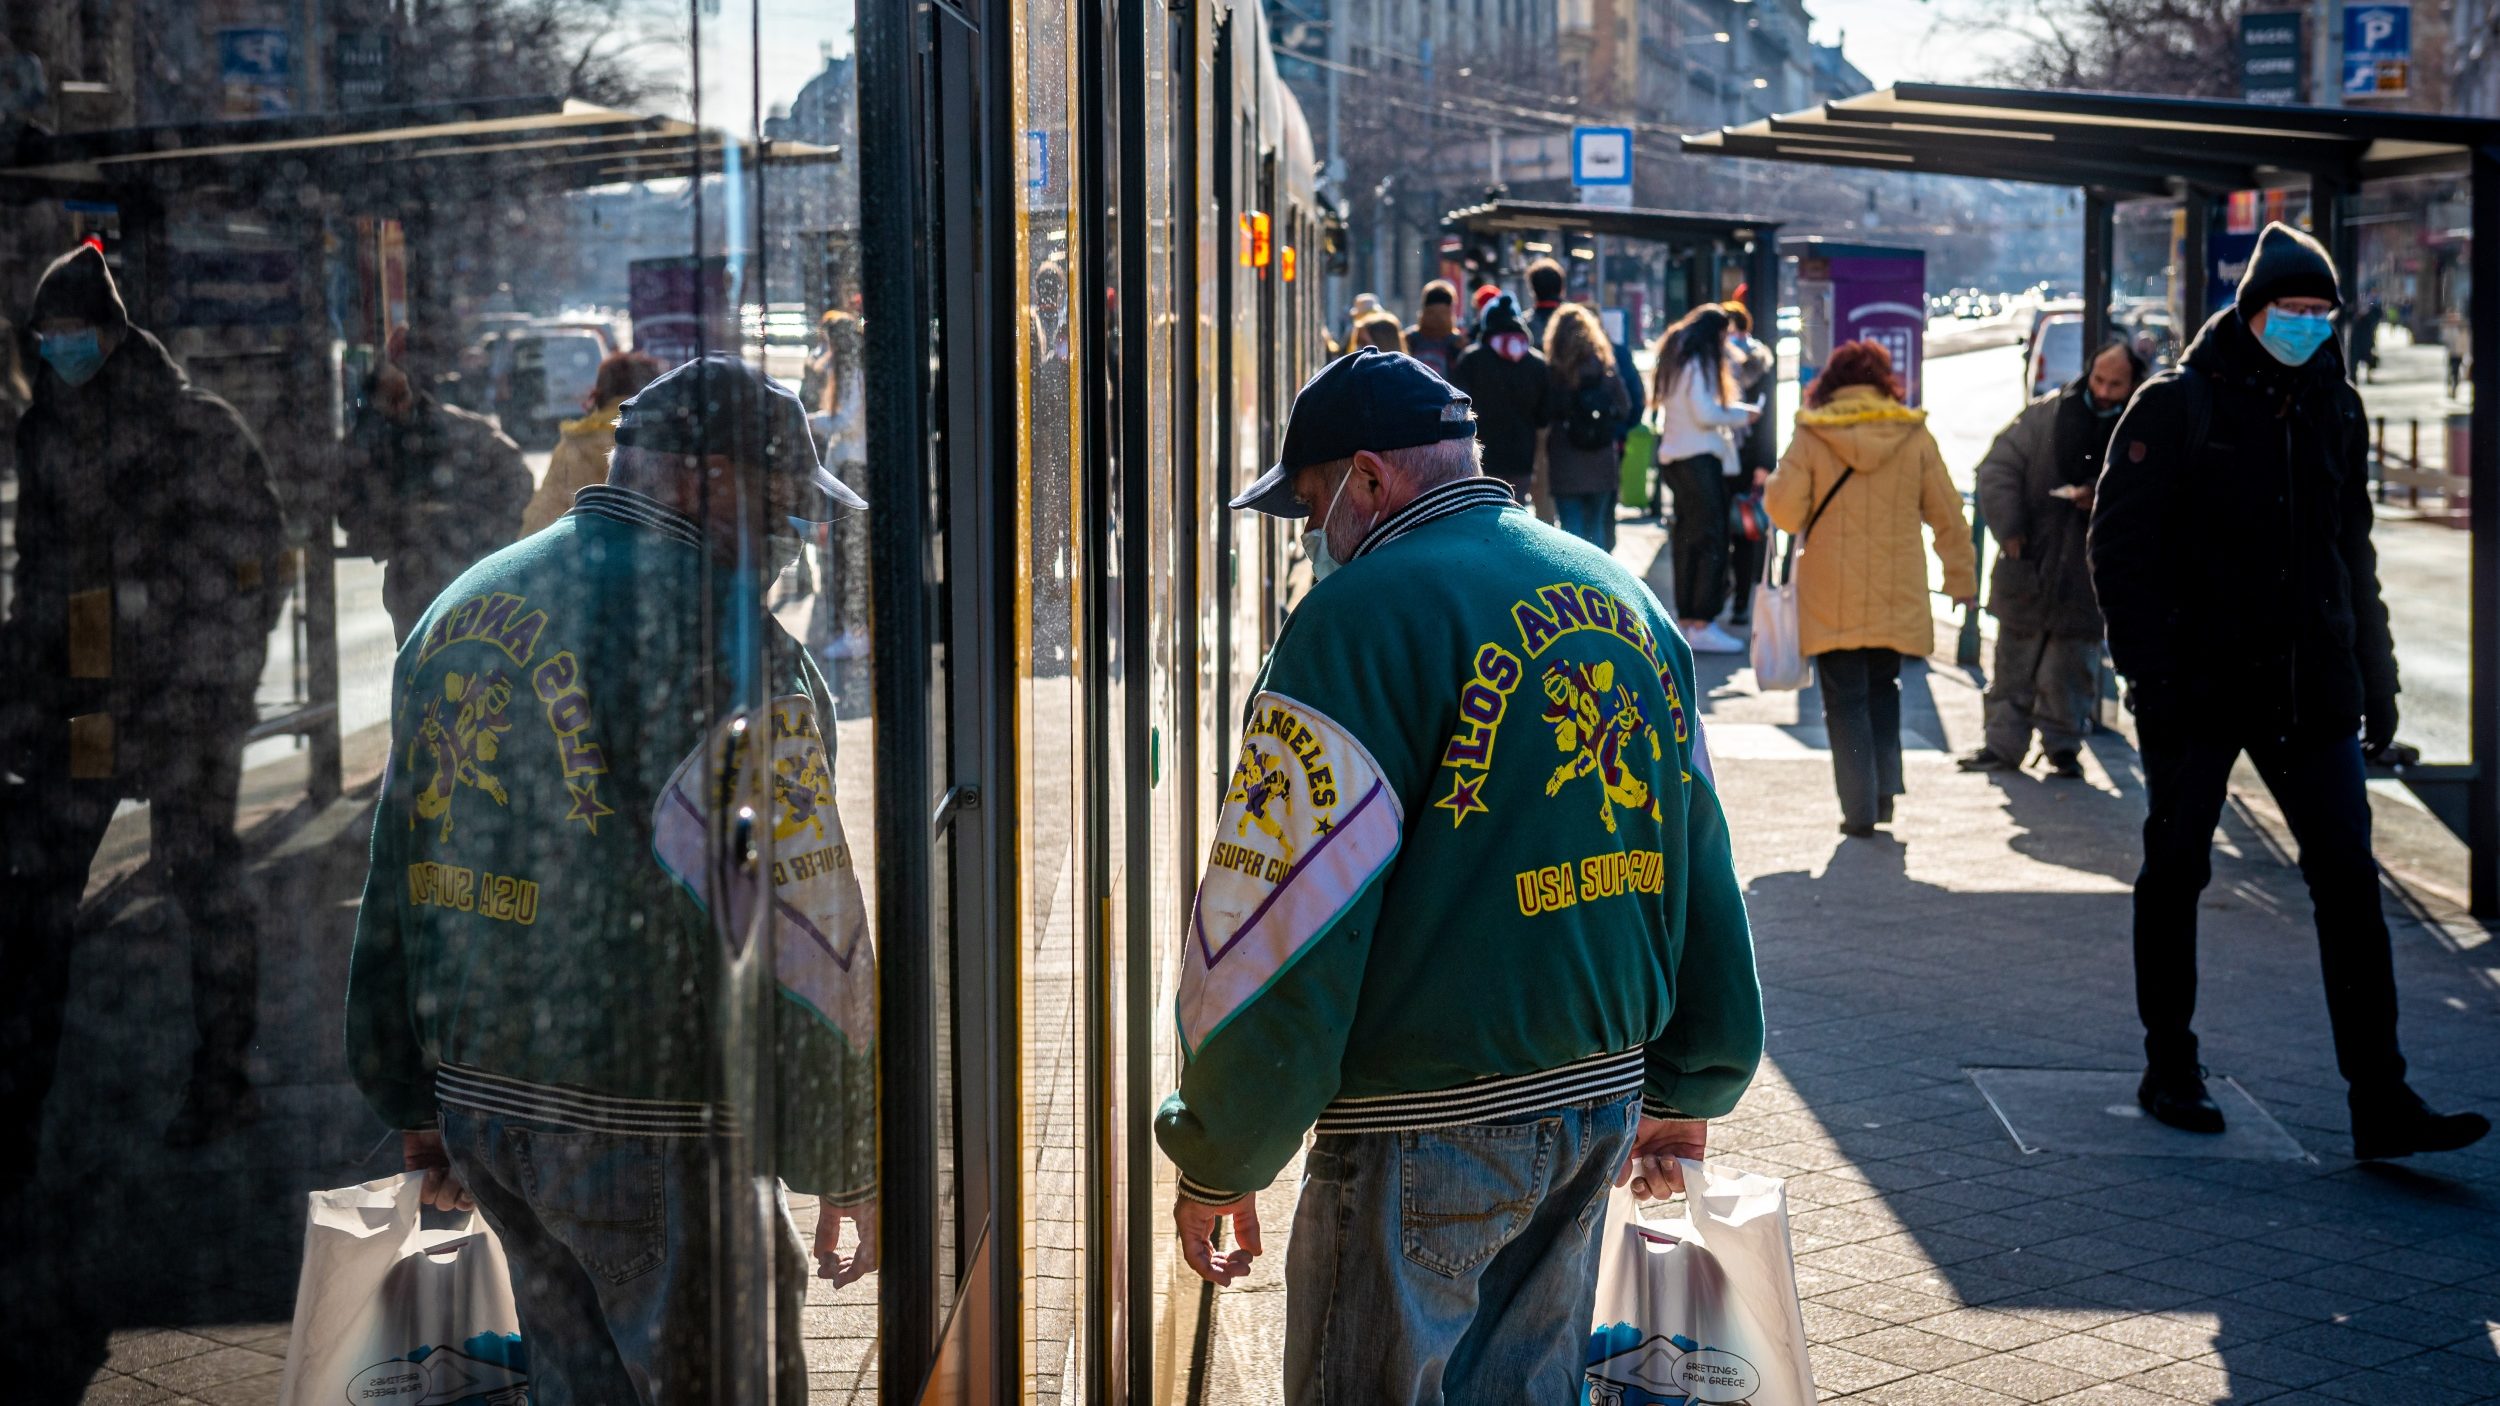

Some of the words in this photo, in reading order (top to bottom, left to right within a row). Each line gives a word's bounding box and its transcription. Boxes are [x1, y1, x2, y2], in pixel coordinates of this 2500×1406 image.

[2246, 58, 2295, 75] COFFEE
[1441, 642, 1523, 770] LOS
[1249, 706, 1339, 812] ANGELES
[1213, 841, 1266, 878] SUPER
[1515, 861, 1577, 916] USA
[1682, 1372, 1706, 1384] FROM
[1708, 1376, 1745, 1388] GREECE
[1685, 1362, 1739, 1376] GREETINGS
